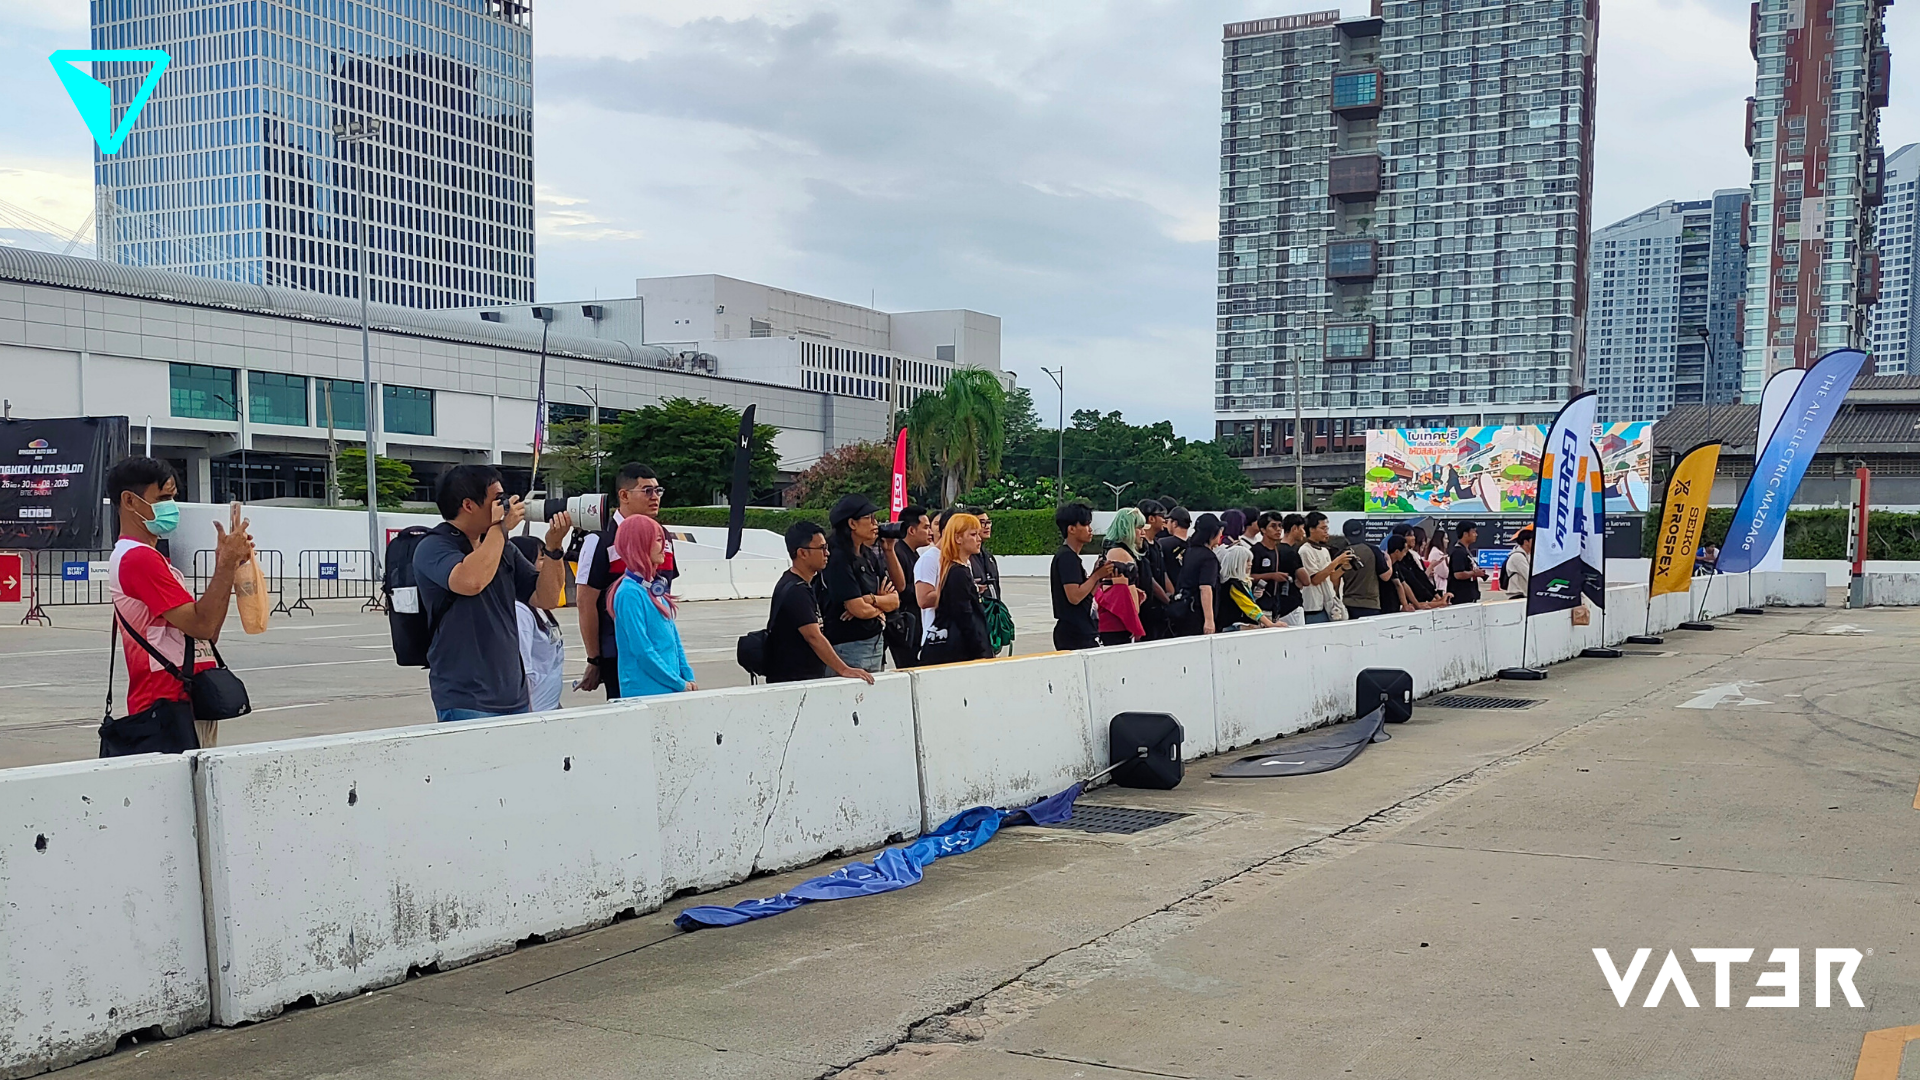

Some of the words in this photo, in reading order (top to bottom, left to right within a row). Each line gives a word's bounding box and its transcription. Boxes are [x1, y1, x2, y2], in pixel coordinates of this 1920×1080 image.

[1816, 374, 1837, 397] THE
[1769, 403, 1821, 488] ALL-ELECTRIC
[21, 480, 31, 488] 30
[31, 464, 56, 474] AUTO
[56, 463, 84, 474] SALON
[894, 476, 902, 508] LEO
[1680, 506, 1700, 556] SEIKO
[1741, 489, 1776, 551] MAZDA6e
[1656, 503, 1685, 577] PROSPEX
[1549, 592, 1577, 600] SPORT
